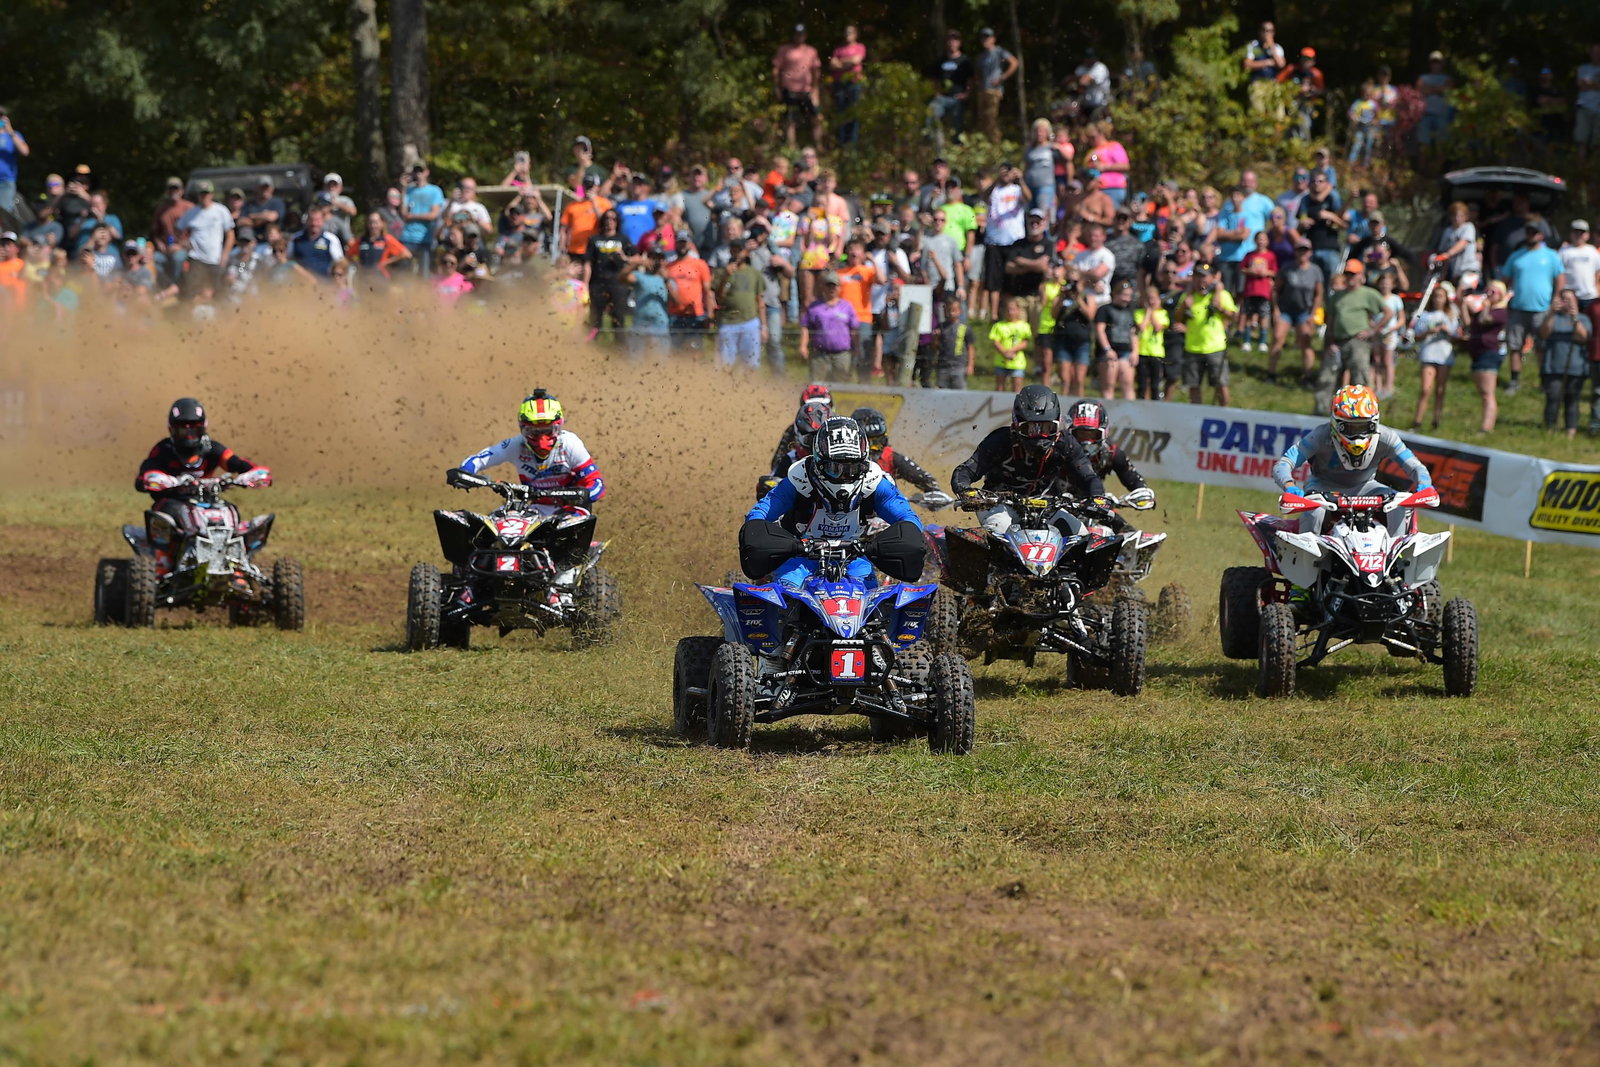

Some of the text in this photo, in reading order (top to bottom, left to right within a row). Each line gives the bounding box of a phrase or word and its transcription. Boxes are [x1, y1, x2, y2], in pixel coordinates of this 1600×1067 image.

[1078, 403, 1099, 417] FLY
[831, 426, 858, 441] FLY
[1200, 418, 1312, 456] PART
[1196, 451, 1311, 482] UNLIM
[501, 520, 524, 534] 2
[501, 556, 516, 571] 2
[1360, 555, 1383, 568] 712
[834, 599, 854, 614] 1
[840, 652, 857, 677] 1
